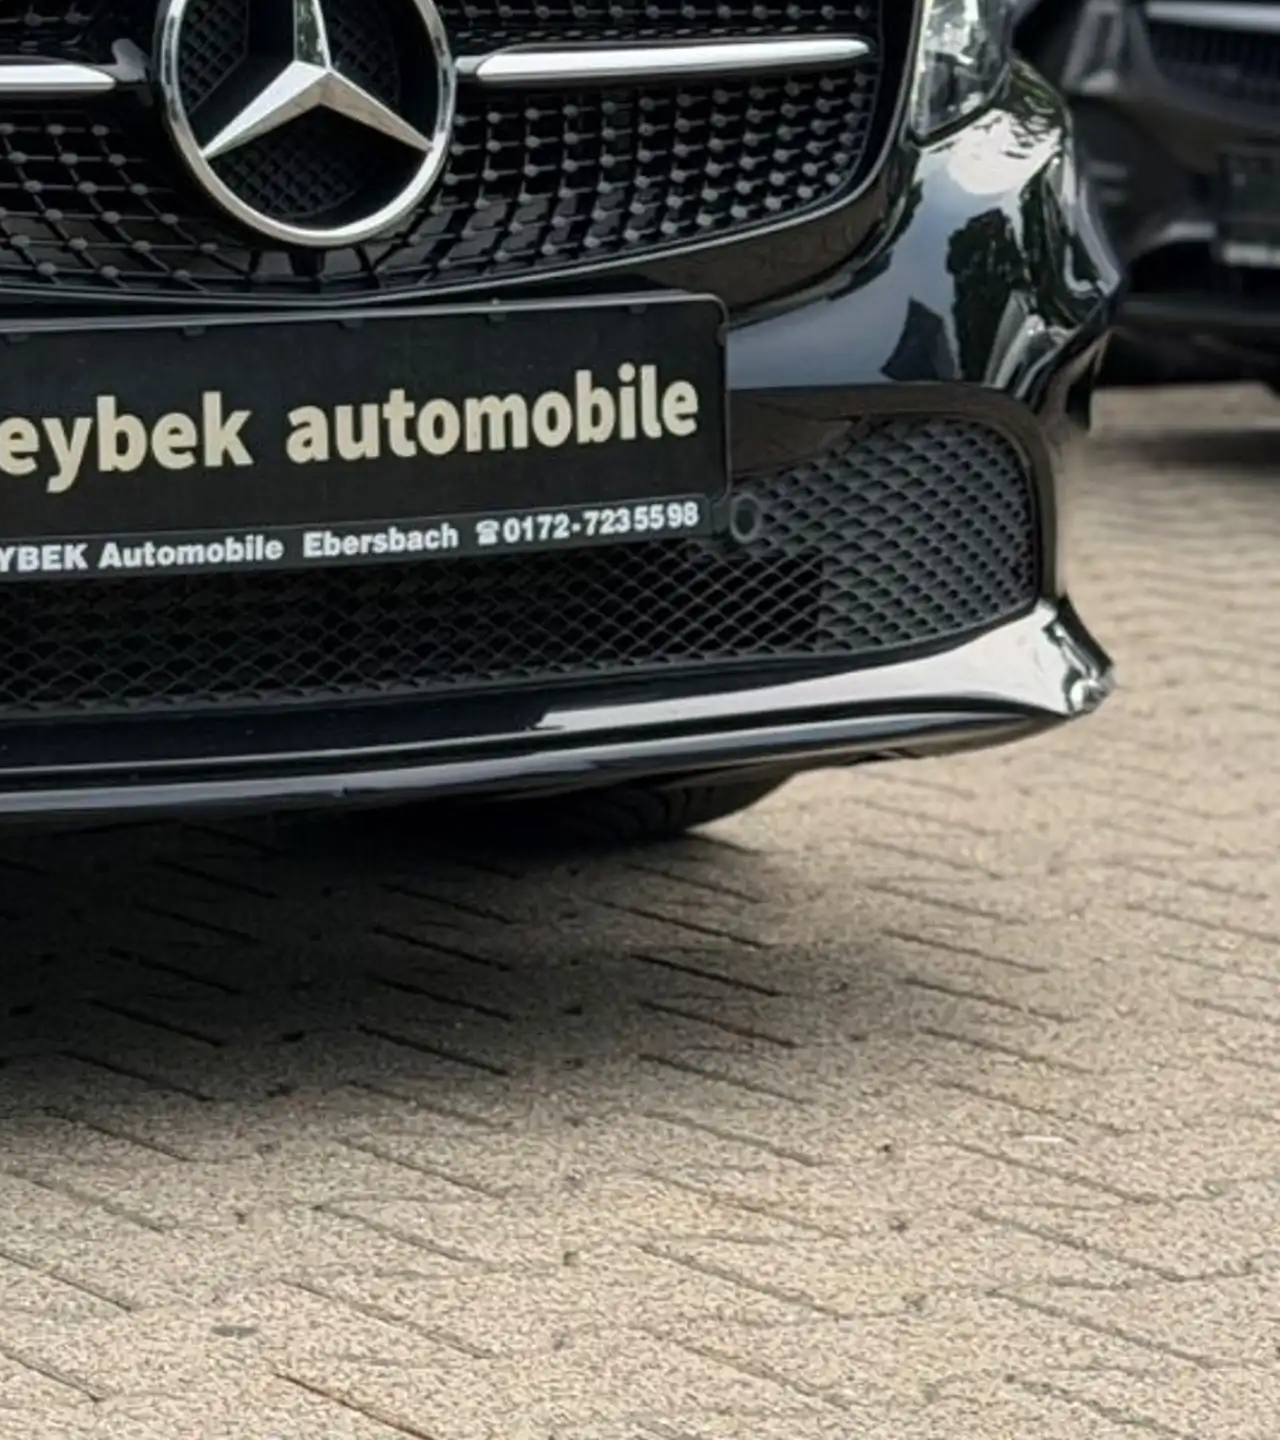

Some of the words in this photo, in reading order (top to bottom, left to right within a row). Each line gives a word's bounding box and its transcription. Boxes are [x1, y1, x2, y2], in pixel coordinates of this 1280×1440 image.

[285, 363, 699, 464] automobile
[98, 534, 284, 569] Automobile
[303, 522, 459, 558] Ebersbach
